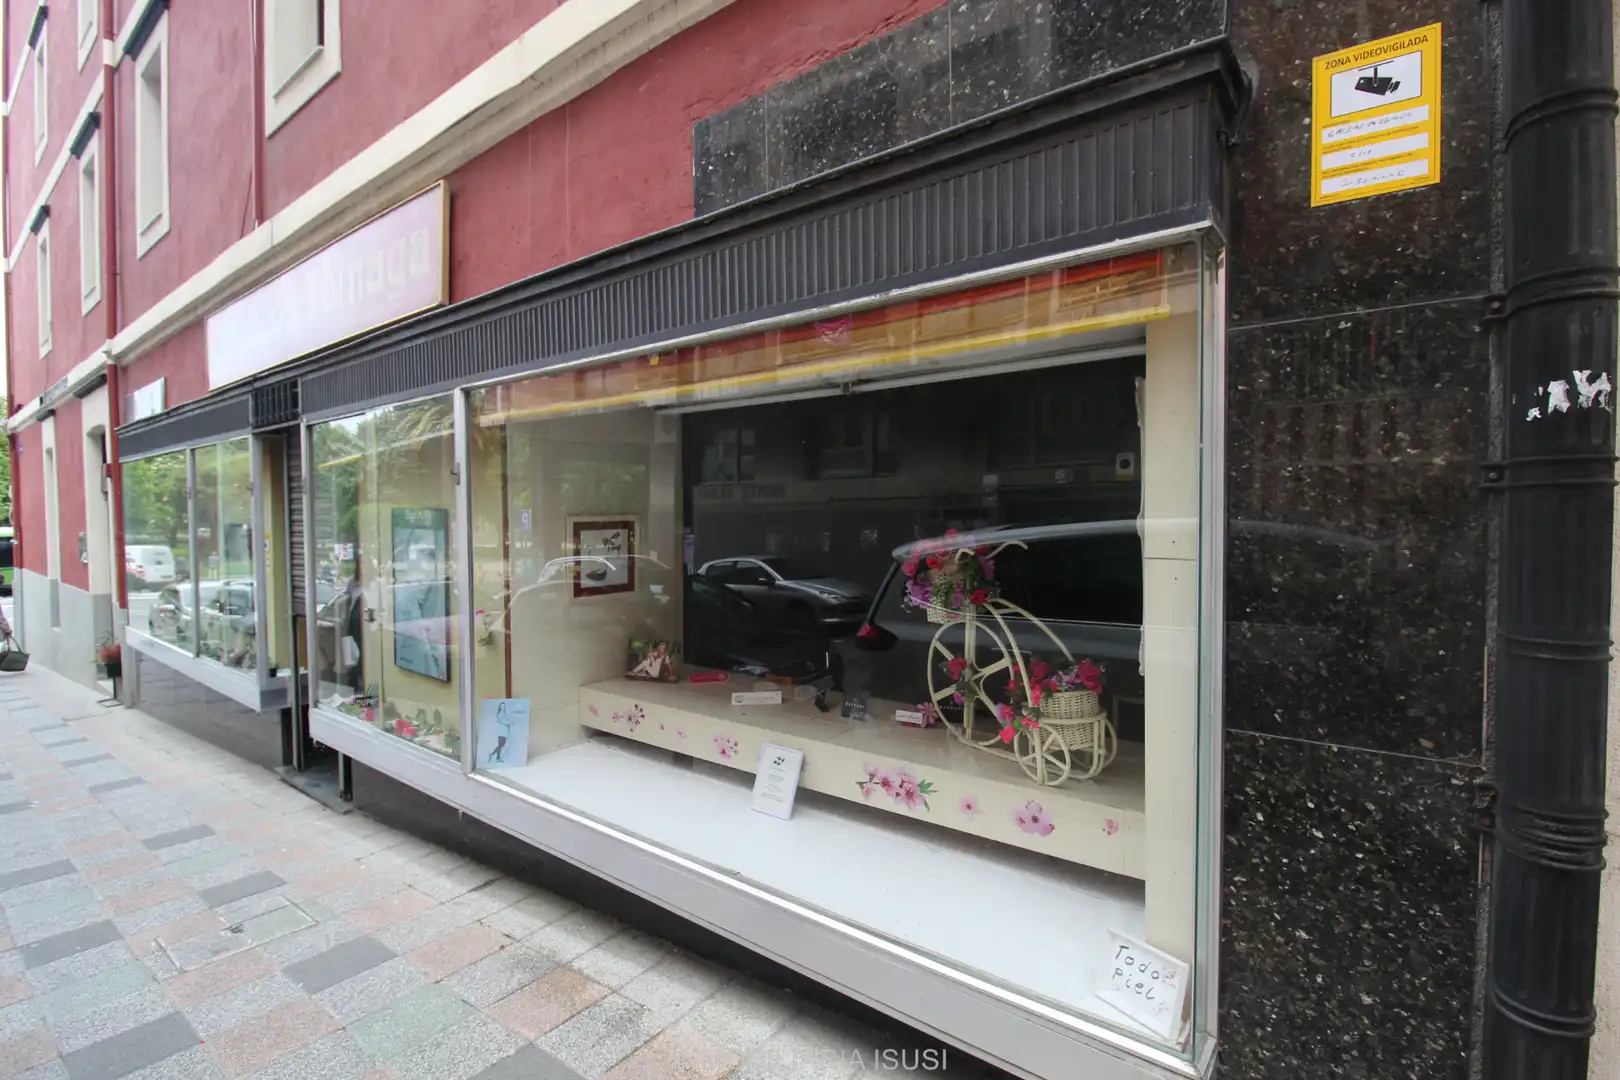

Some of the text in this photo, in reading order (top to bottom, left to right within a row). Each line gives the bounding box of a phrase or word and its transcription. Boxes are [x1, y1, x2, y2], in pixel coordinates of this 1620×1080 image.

[1325, 34, 1429, 70] ZONA VIDEOVIGILADA
[1115, 944, 1160, 980] Todo
